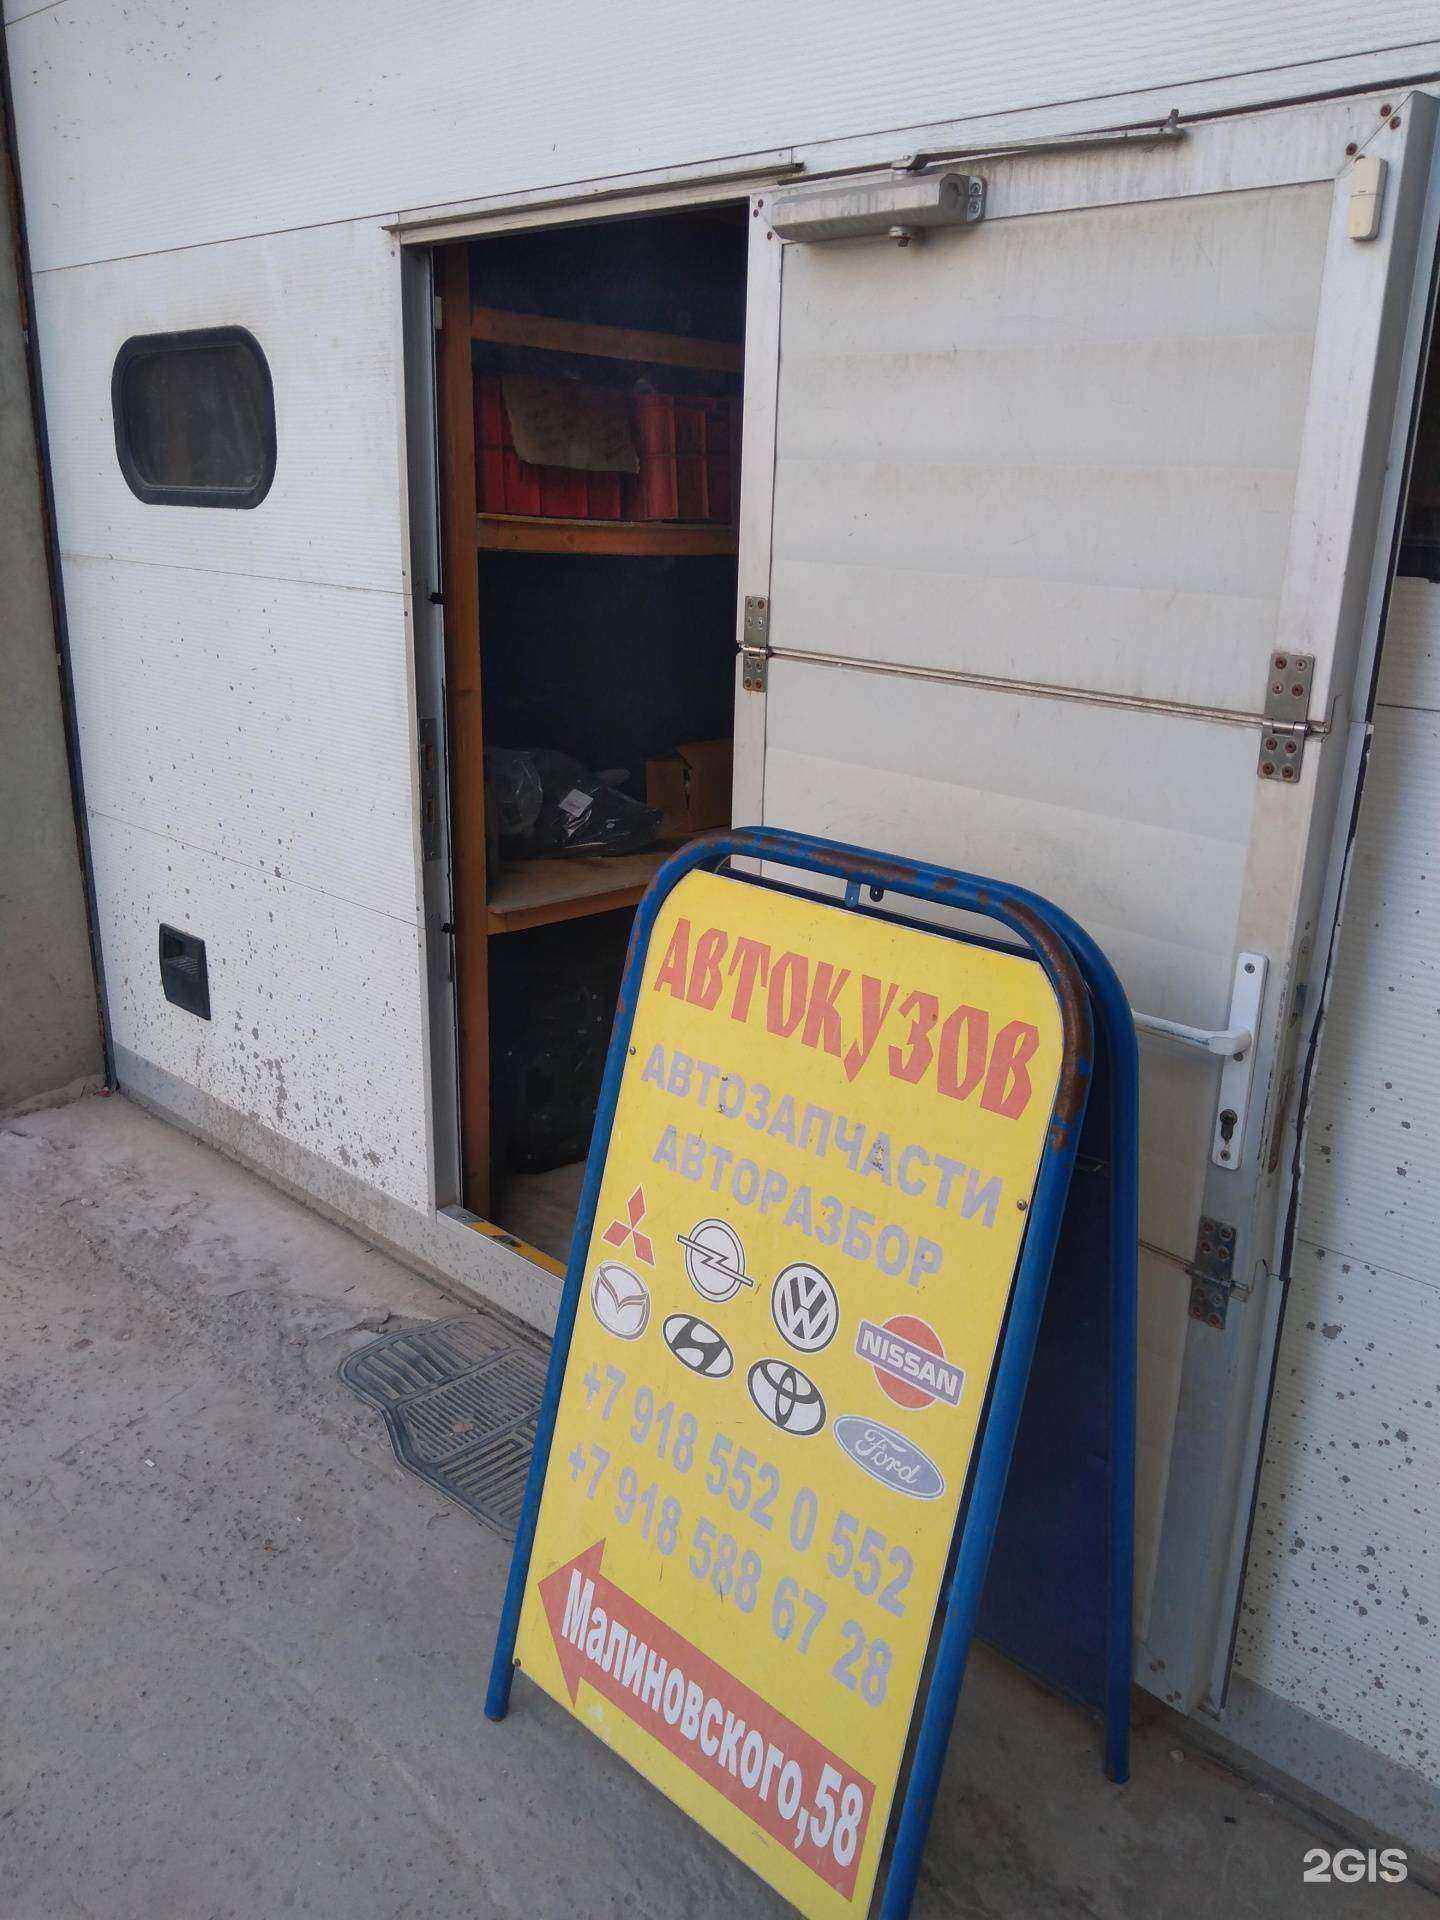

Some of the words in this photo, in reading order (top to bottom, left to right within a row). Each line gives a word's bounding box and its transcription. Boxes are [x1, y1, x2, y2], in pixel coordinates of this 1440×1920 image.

[653, 917, 1040, 1120] АВТОКУЗОВ
[640, 1043, 1003, 1229] АВТОЗАПЧАСТИ
[651, 1123, 944, 1287] АВТОРАЗБОР
[860, 1329, 960, 1397] NISSAN
[583, 1362, 627, 1420] +7
[630, 1385, 698, 1475] 918
[705, 1431, 781, 1532] 552
[789, 1486, 819, 1552] 0
[828, 1512, 914, 1617] 552
[853, 1429, 920, 1485] Ford
[568, 1441, 612, 1501] +7
[614, 1465, 682, 1557] 918
[688, 1516, 762, 1614] 588
[772, 1576, 828, 1655] 67
[831, 1619, 893, 1708] 28
